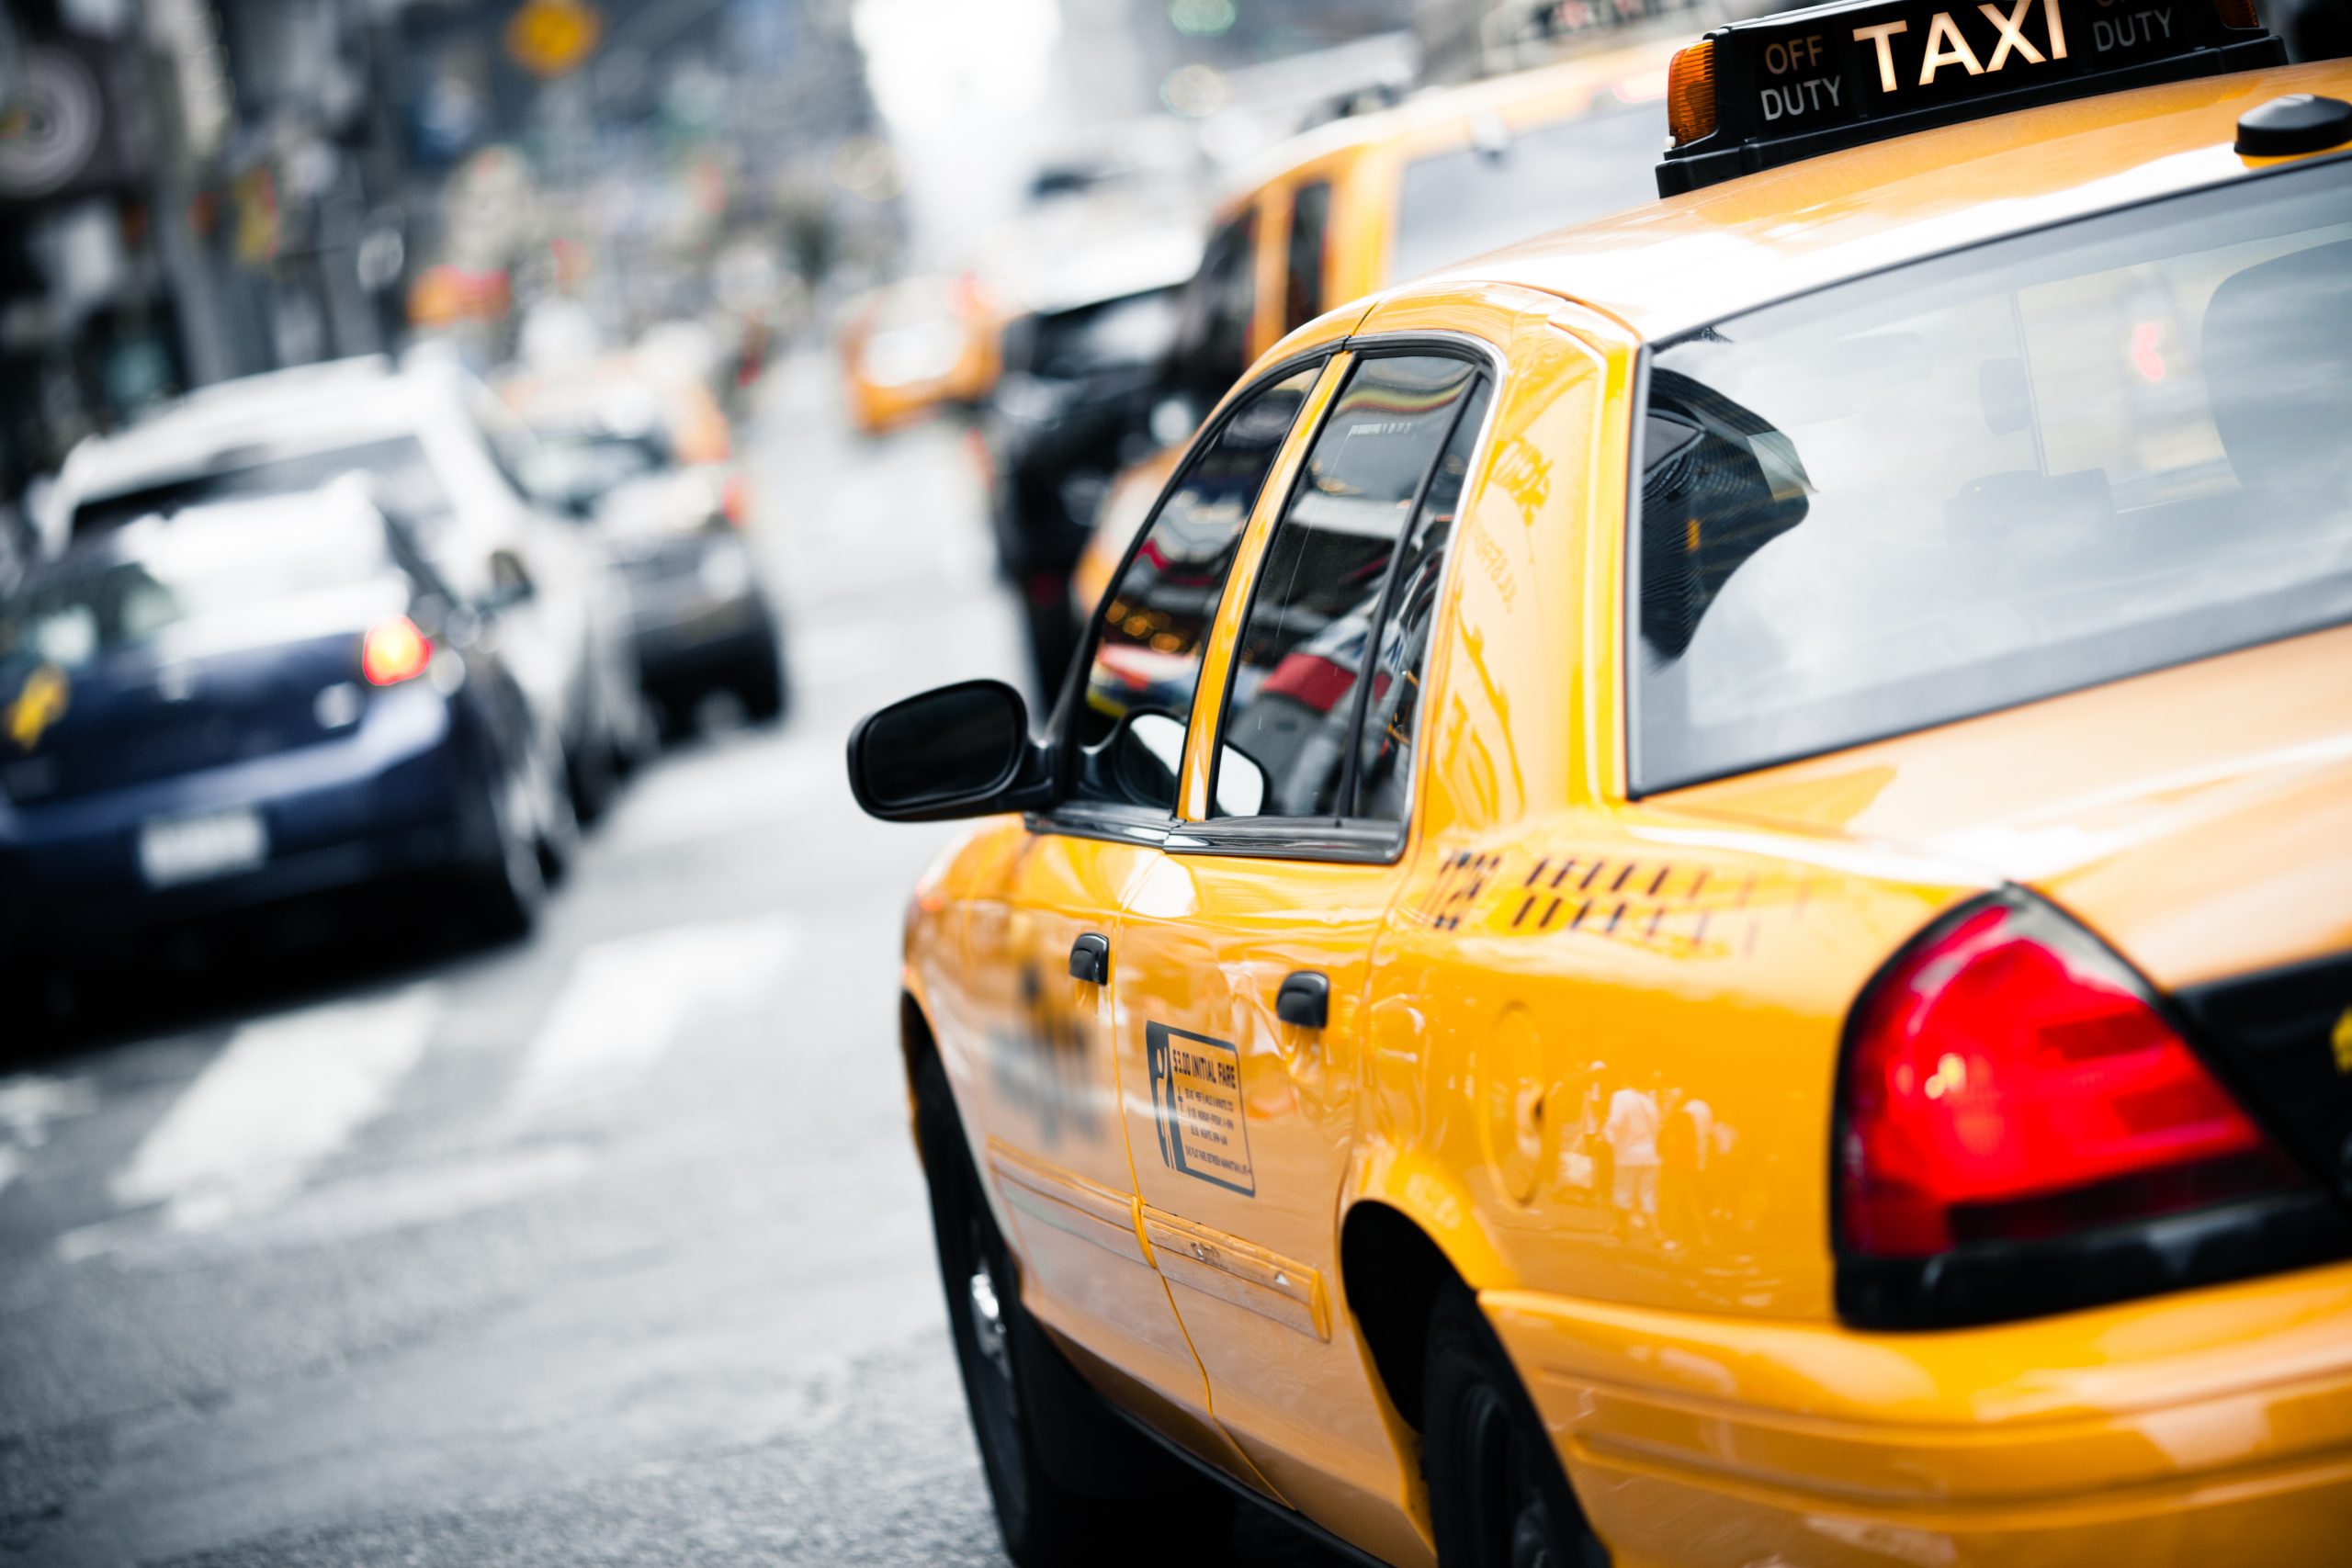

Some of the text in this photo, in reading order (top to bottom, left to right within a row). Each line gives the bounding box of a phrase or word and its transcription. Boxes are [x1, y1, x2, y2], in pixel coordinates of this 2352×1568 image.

[1853, 0, 2068, 93] TAXI
[2091, 6, 2173, 52] DUTY
[1765, 35, 1824, 75] OFF
[1759, 74, 1842, 122] DUTY
[1191, 1055, 1217, 1084] INITIAL
[1218, 1063, 1236, 1089] FARE
